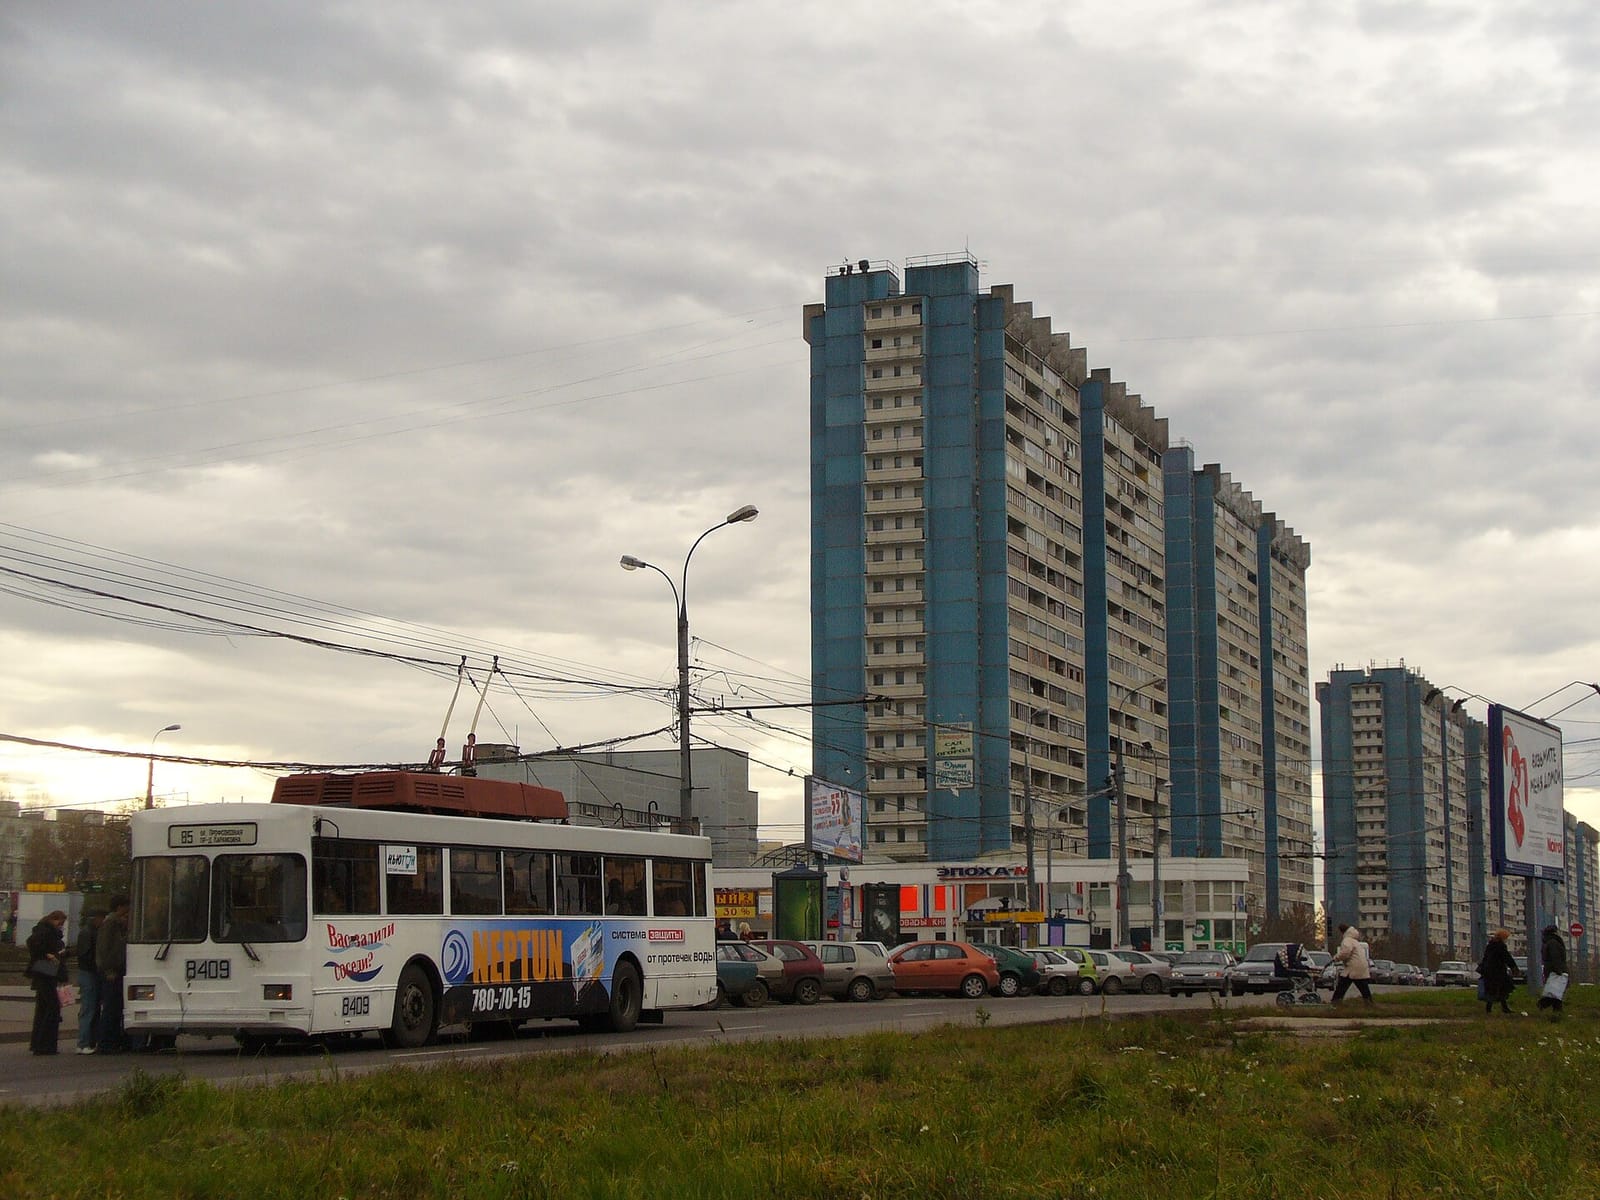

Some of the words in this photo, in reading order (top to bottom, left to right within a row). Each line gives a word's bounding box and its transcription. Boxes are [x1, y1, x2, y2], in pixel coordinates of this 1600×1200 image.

[181, 831, 193, 843] 85
[612, 931, 647, 940] система
[649, 931, 682, 941] защиты
[335, 951, 374, 981] соседи?
[472, 930, 563, 984] NEPTUN
[647, 955, 656, 963] от
[658, 953, 692, 965] протечек
[186, 960, 230, 979] 8409
[342, 995, 370, 1017] 8409
[472, 986, 532, 1012] 780-70-15
